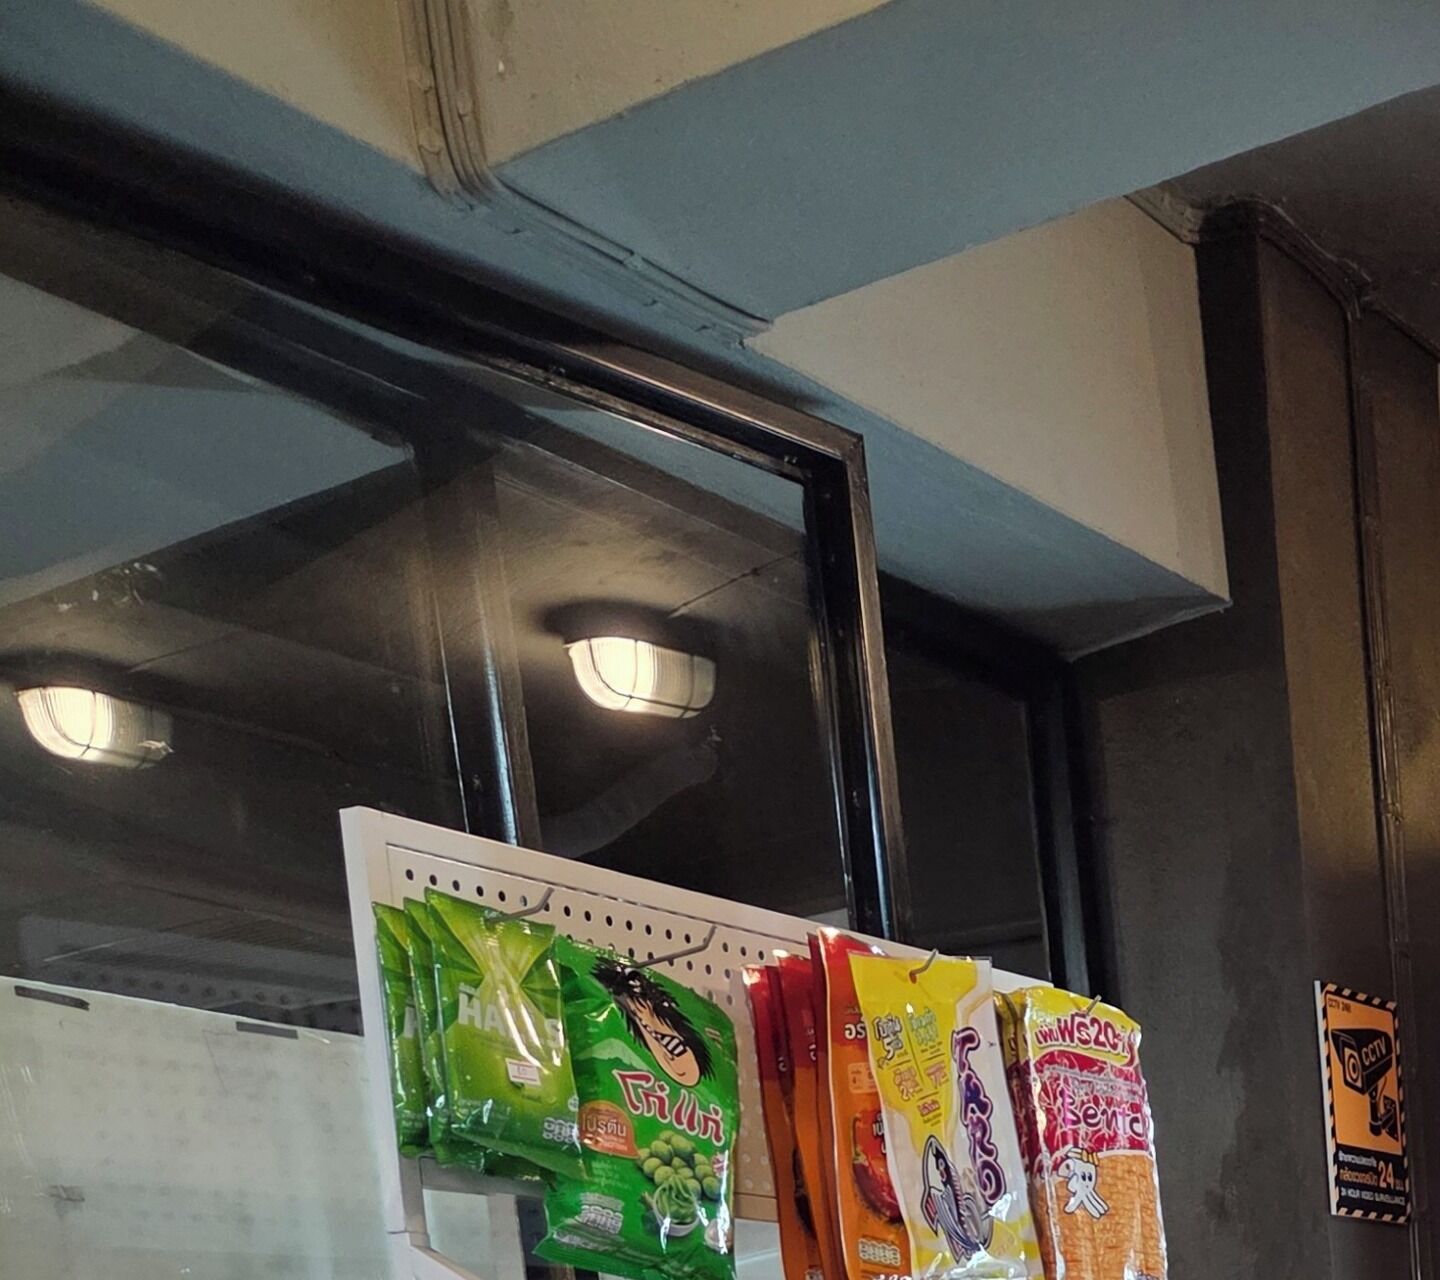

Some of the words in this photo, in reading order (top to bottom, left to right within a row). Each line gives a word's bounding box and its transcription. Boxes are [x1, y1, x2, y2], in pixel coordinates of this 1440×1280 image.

[1361, 1036, 1386, 1066] CCTV
[950, 1026, 1018, 1207] TARO
[1378, 1160, 1395, 1190] 24
